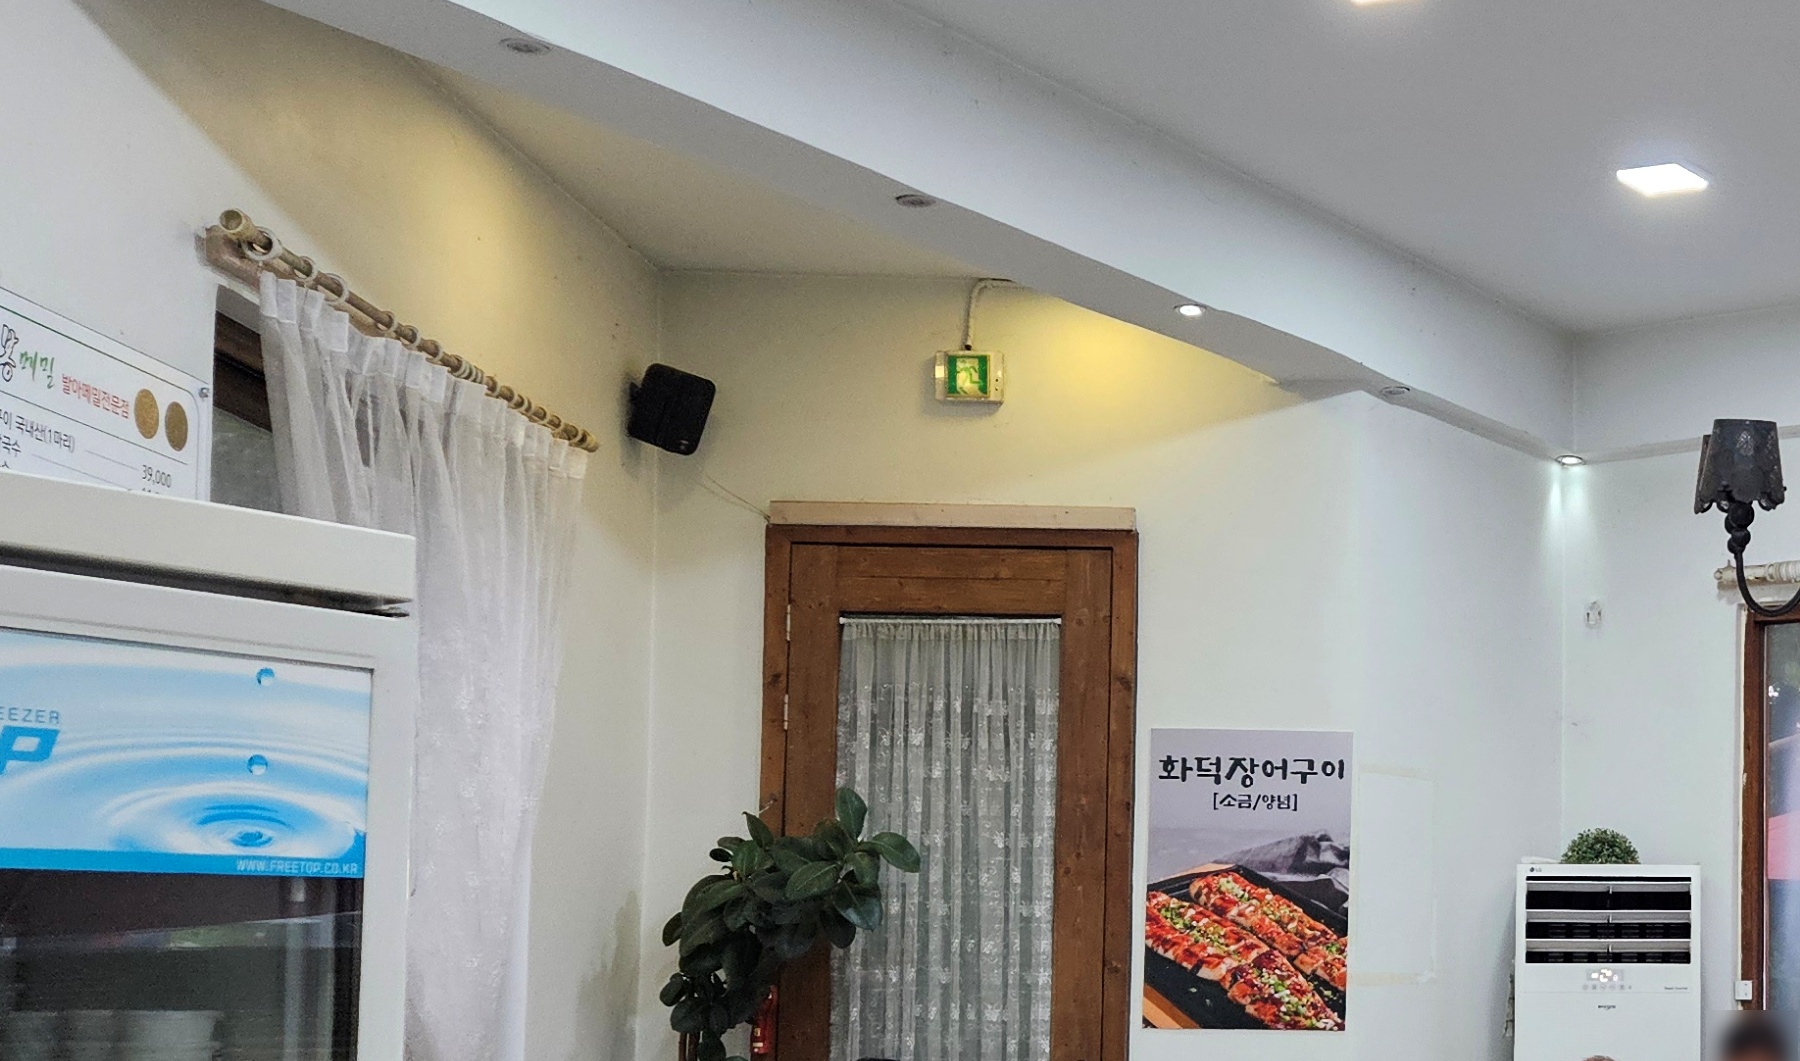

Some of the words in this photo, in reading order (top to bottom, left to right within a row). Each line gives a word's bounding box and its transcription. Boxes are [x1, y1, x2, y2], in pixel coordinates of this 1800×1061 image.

[61, 373, 130, 420] 발아메밀전문점
[0, 434, 22, 457] 국수
[15, 415, 75, 454] 국내산(1마리)
[142, 464, 172, 488] 39,000
[1158, 755, 1346, 788] 화덕장어구이
[1213, 793, 1298, 811] [소금/양념]
[236, 859, 358, 875] WWW.FREETOP.CO.KR
